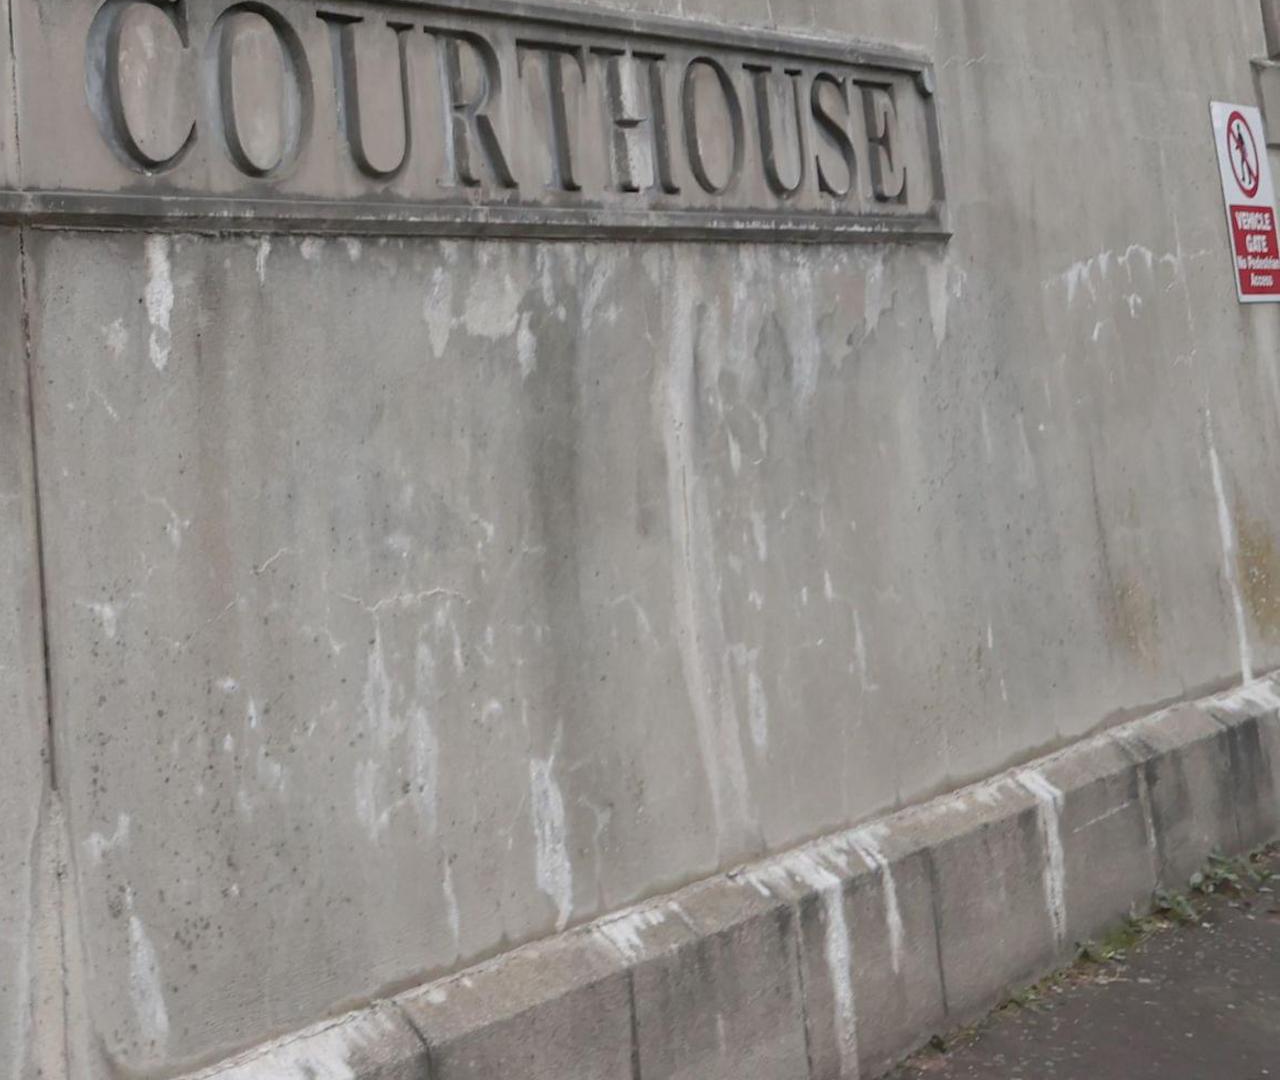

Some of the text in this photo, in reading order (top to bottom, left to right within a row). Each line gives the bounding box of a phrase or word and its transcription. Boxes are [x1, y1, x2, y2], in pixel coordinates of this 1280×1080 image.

[1235, 211, 1271, 230] VEHICLE
[1246, 233, 1268, 253] GATE
[1236, 255, 1246, 269] No
[1250, 273, 1273, 287] Access
